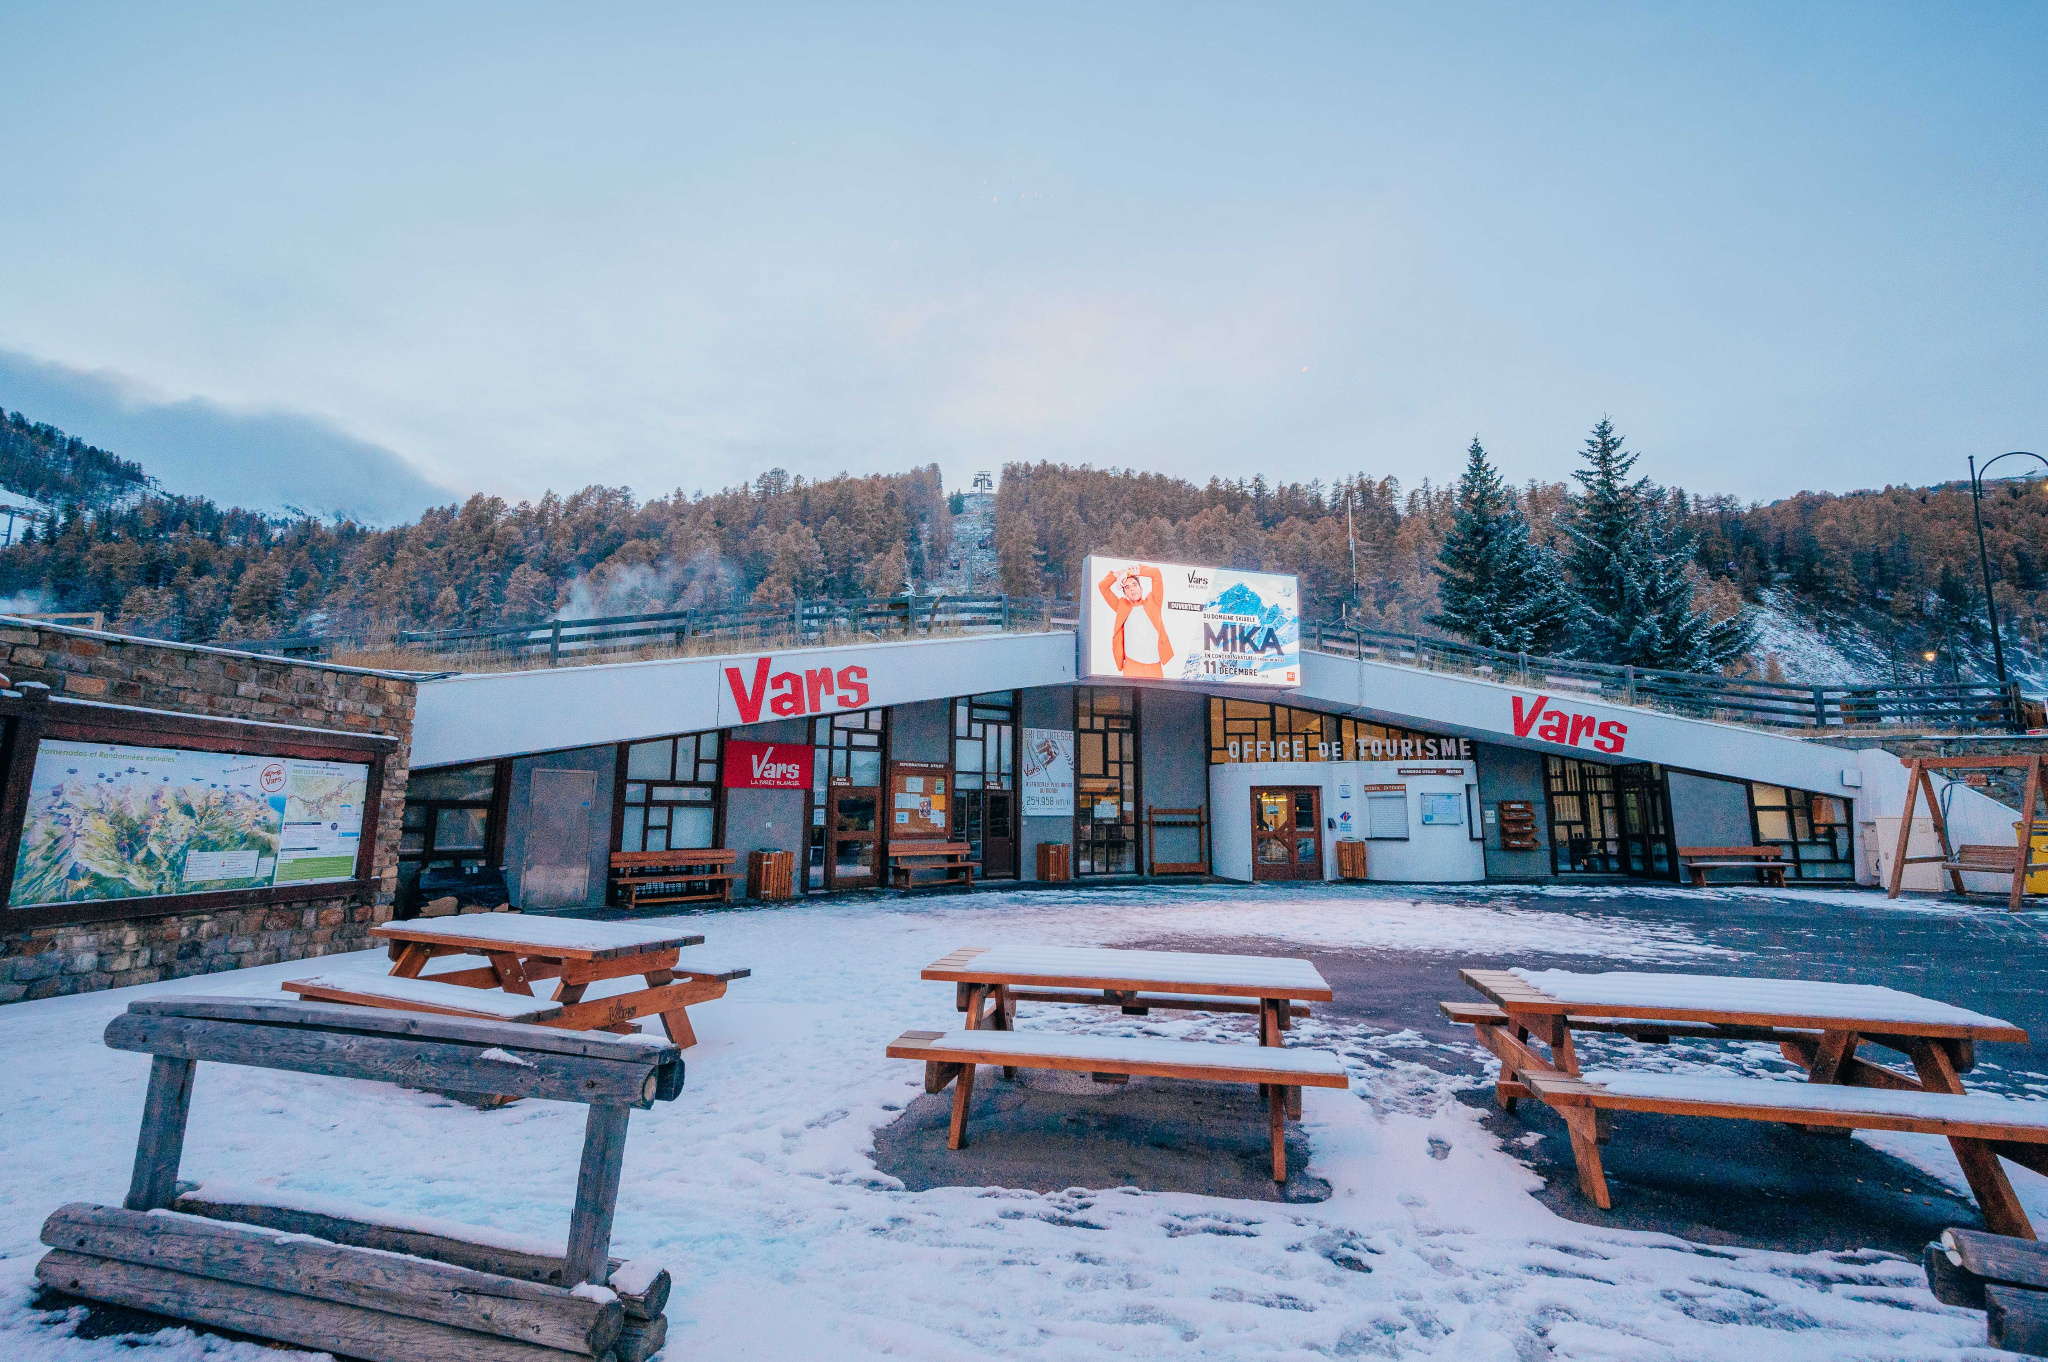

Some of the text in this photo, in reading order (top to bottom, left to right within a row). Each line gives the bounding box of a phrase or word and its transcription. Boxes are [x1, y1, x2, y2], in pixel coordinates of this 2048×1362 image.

[1187, 570, 1208, 585] Vars
[1171, 602, 1201, 611] OUVERTURE
[1211, 613, 1234, 621] DOMAINE
[1203, 622, 1284, 655] MIKA
[1203, 660, 1217, 674] 11
[724, 657, 870, 724] Vars
[1512, 695, 1628, 753] Vars
[1023, 729, 1073, 741] SKI DE VITESSE
[38, 746, 87, 757] Promenades
[99, 750, 144, 761] Randonnées
[146, 754, 175, 762] estivales
[1228, 738, 1471, 759] OFFICE DE TOURISME
[751, 746, 800, 779] Vars
[1023, 763, 1041, 777] Vars
[265, 775, 282, 786] Vars
[1966, 776, 1987, 784] VARS
[608, 999, 637, 1022] Vars
